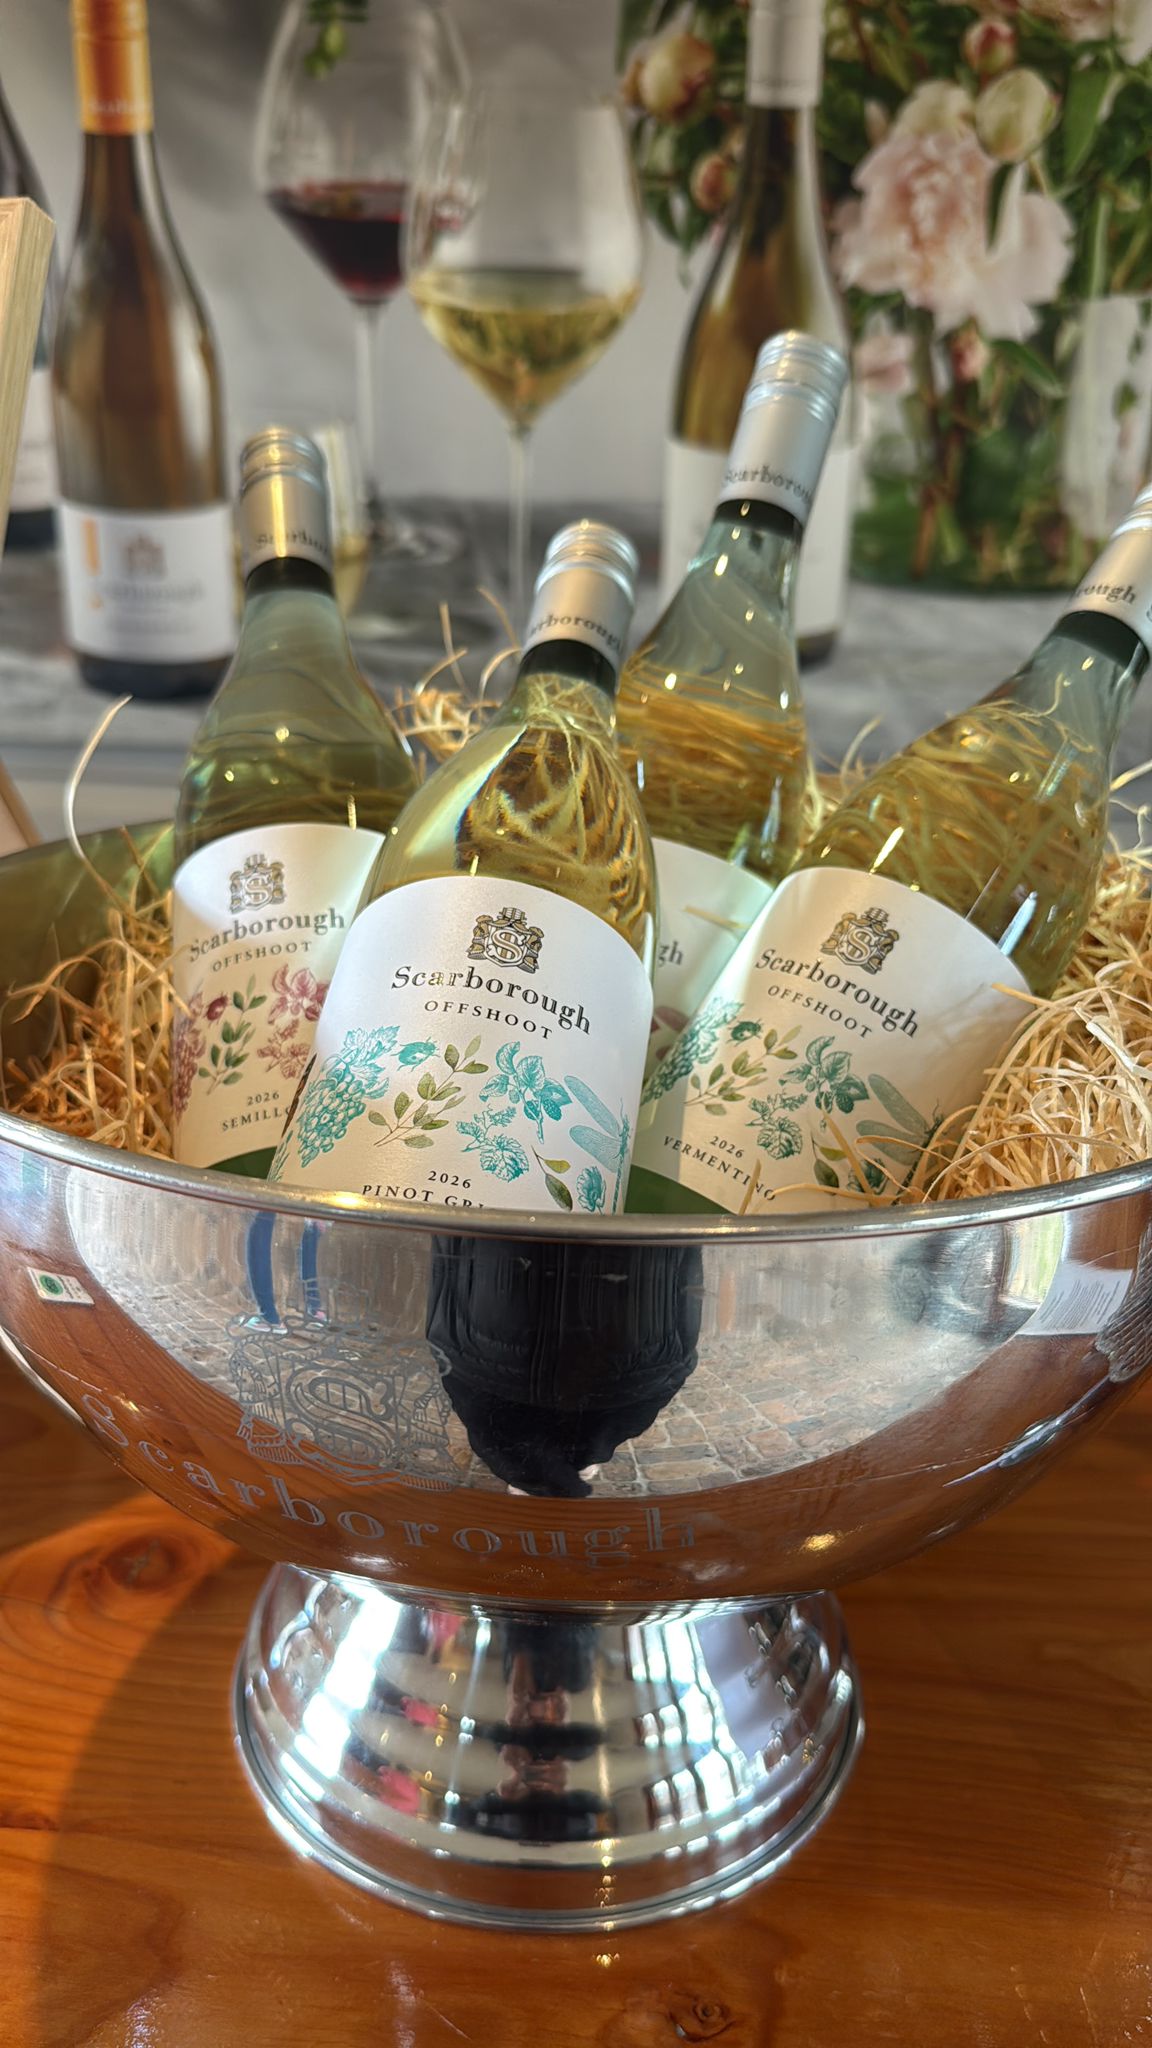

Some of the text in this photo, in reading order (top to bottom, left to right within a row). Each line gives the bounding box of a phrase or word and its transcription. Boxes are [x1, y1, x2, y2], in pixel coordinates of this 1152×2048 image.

[188, 907, 346, 963] Scarborough
[211, 941, 313, 973] OFFSHOOT
[391, 965, 591, 1035] Scarborough
[755, 948, 919, 1038] Scarborough
[767, 985, 873, 1039] OFFSHOOT
[424, 1000, 553, 1040] OFFSHOOT
[247, 1091, 280, 1106] 2026
[709, 1135, 745, 1159] 2026
[361, 1184, 434, 1202] PINOT
[428, 1170, 472, 1189] 2026
[81, 1393, 696, 1569] Scarborough
